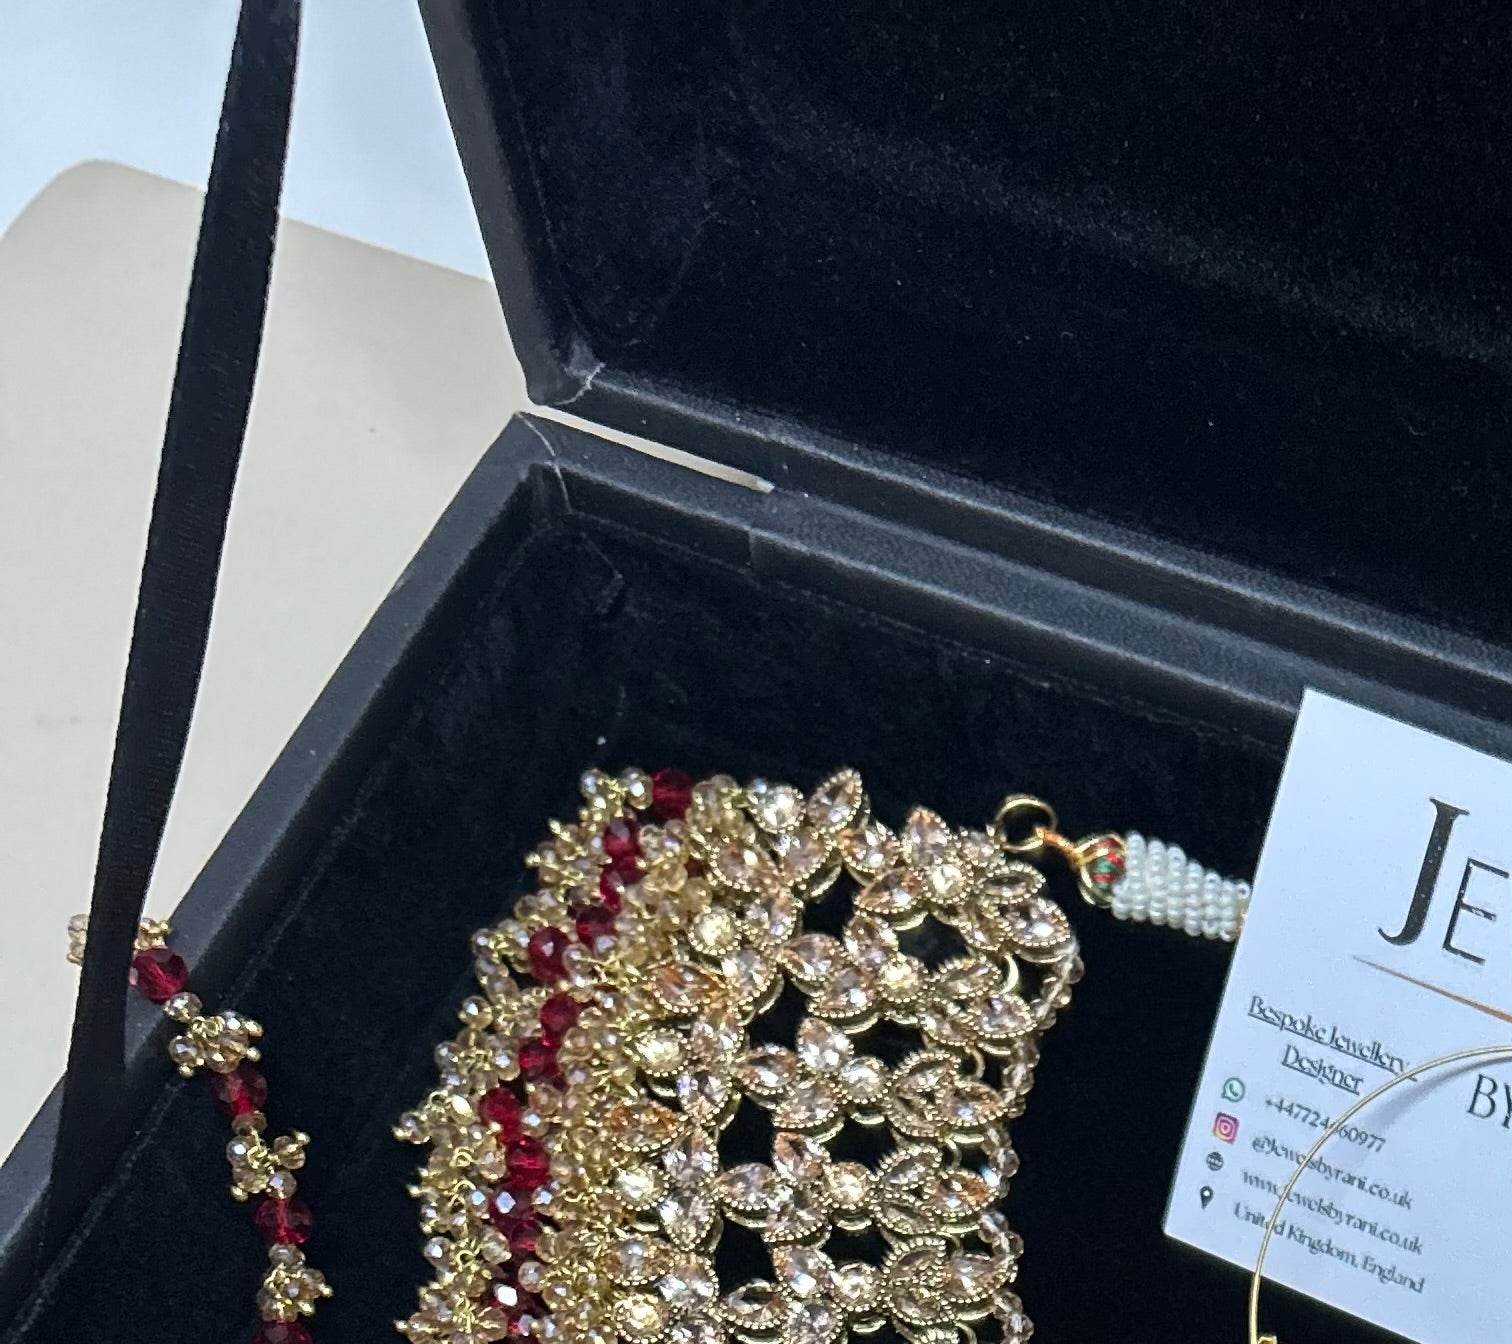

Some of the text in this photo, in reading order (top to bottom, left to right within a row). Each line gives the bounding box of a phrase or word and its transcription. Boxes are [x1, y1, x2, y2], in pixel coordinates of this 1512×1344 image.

[1248, 995, 1327, 1041] Bespoke
[1282, 1045, 1364, 1095] Designer
[1266, 1098, 1386, 1152] +44772460977
[1362, 1255, 1426, 1294] England
